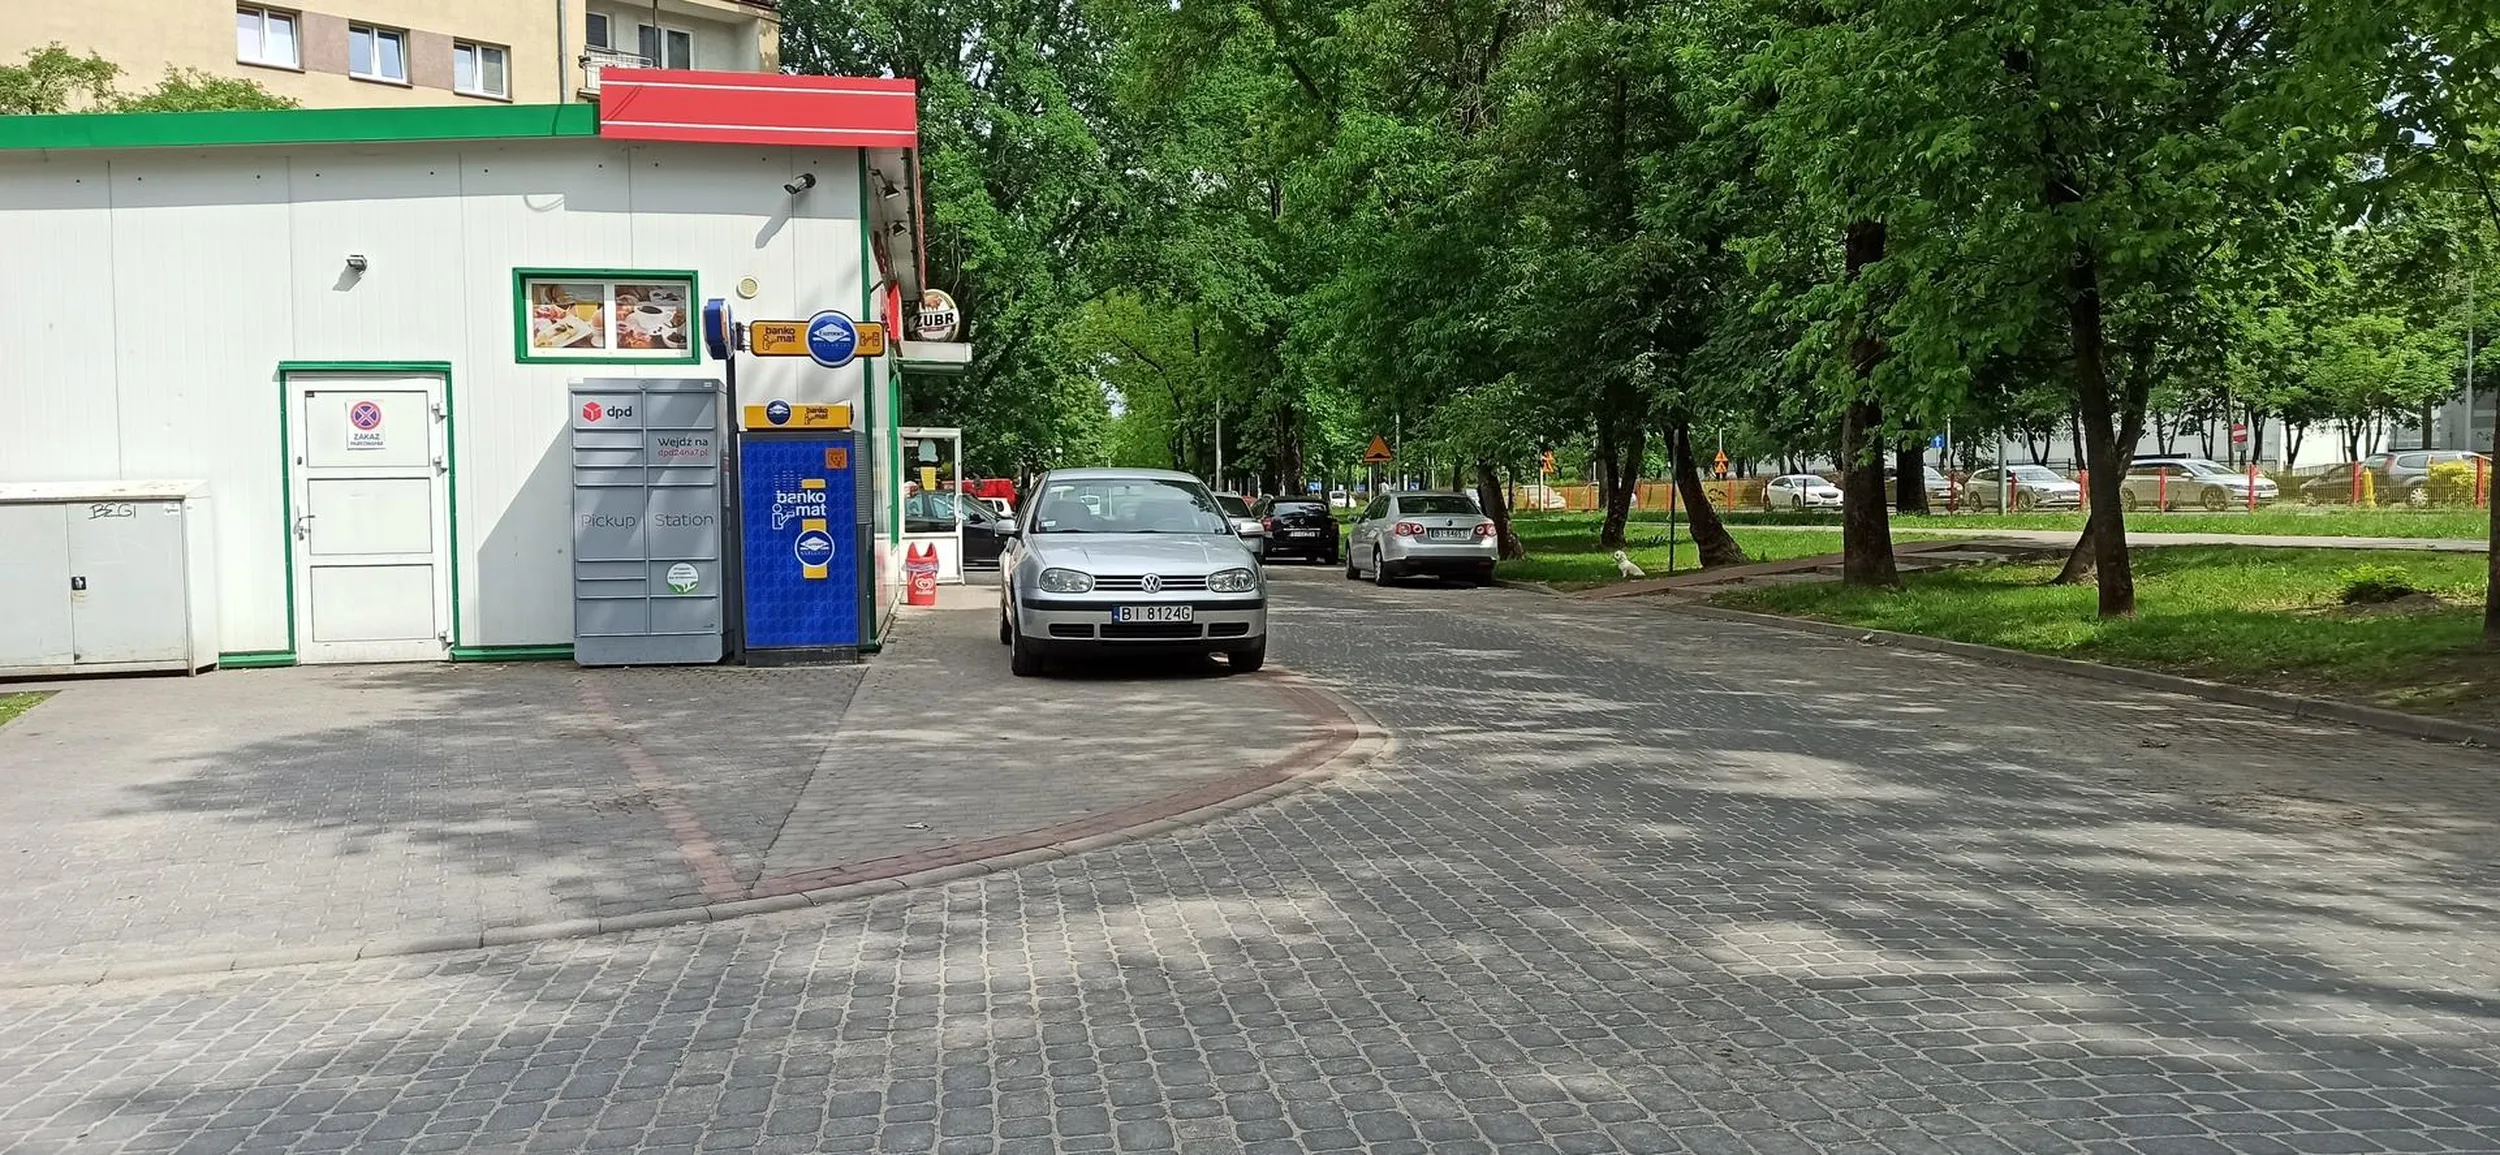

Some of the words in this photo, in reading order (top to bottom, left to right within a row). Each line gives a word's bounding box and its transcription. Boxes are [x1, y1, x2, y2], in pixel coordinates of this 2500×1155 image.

[765, 326, 796, 335] banko
[776, 335, 796, 343] mat
[607, 405, 633, 419] dpd
[353, 433, 381, 441] ZAKAZ
[658, 437, 692, 447] Wejdź
[776, 490, 827, 503] banko
[795, 503, 827, 517] mat
[580, 513, 636, 529] Pickup
[654, 513, 714, 528] Station
[1121, 607, 1140, 621] BI
[1147, 607, 1190, 621] 8124G
